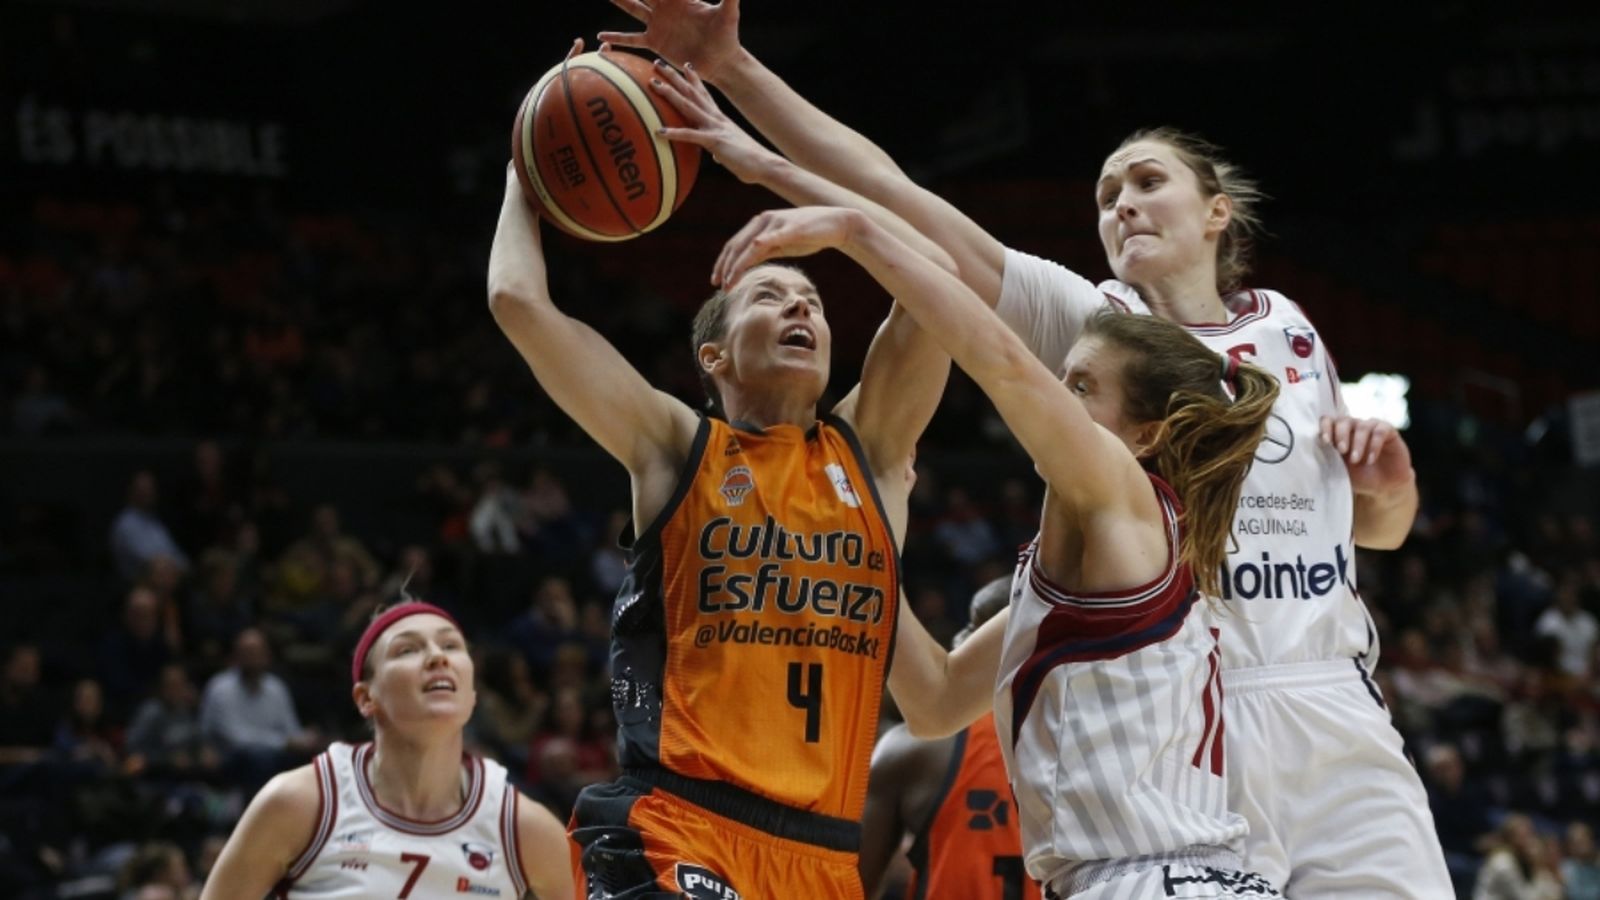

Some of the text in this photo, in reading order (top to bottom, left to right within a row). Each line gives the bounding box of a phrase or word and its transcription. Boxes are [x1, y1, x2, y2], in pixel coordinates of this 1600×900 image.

[586, 96, 647, 201] molten
[1237, 492, 1315, 511] rcedes-Benz
[700, 515, 863, 567] Cultura
[1238, 519, 1308, 536] AGUINAGA
[787, 661, 823, 743] 4
[398, 852, 431, 900] 7
